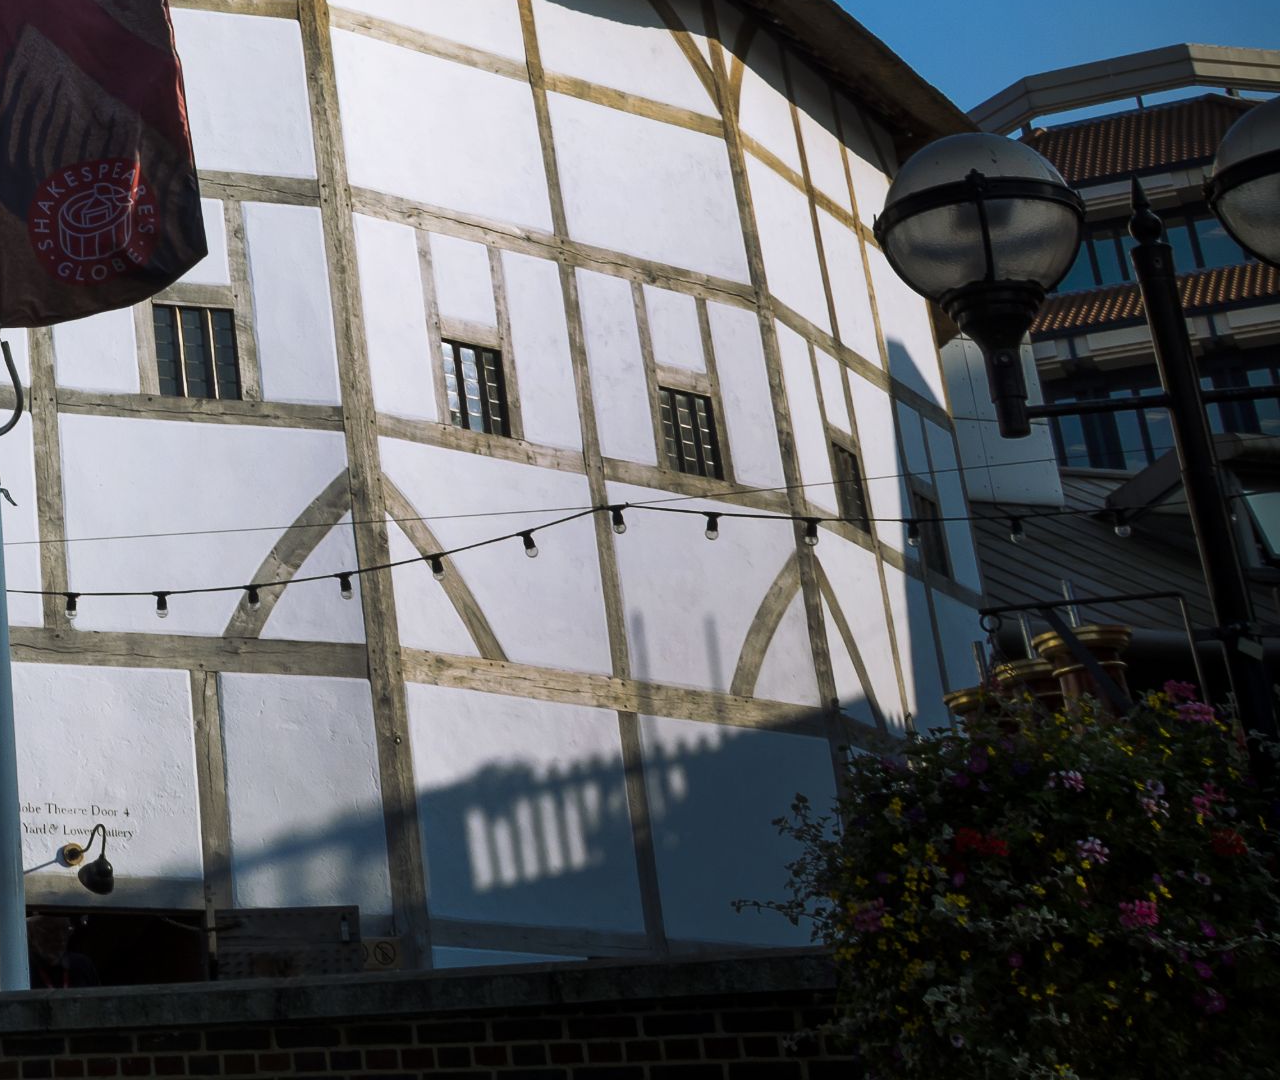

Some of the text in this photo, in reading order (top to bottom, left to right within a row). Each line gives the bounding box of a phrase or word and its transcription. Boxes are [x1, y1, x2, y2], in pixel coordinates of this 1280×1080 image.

[34, 162, 155, 250] SHAKESPEARE'S
[57, 247, 144, 281] GLOBE
[18, 802, 42, 814] lobe
[91, 804, 119, 817] Door
[123, 807, 130, 817] 4
[22, 822, 46, 834] Yard
